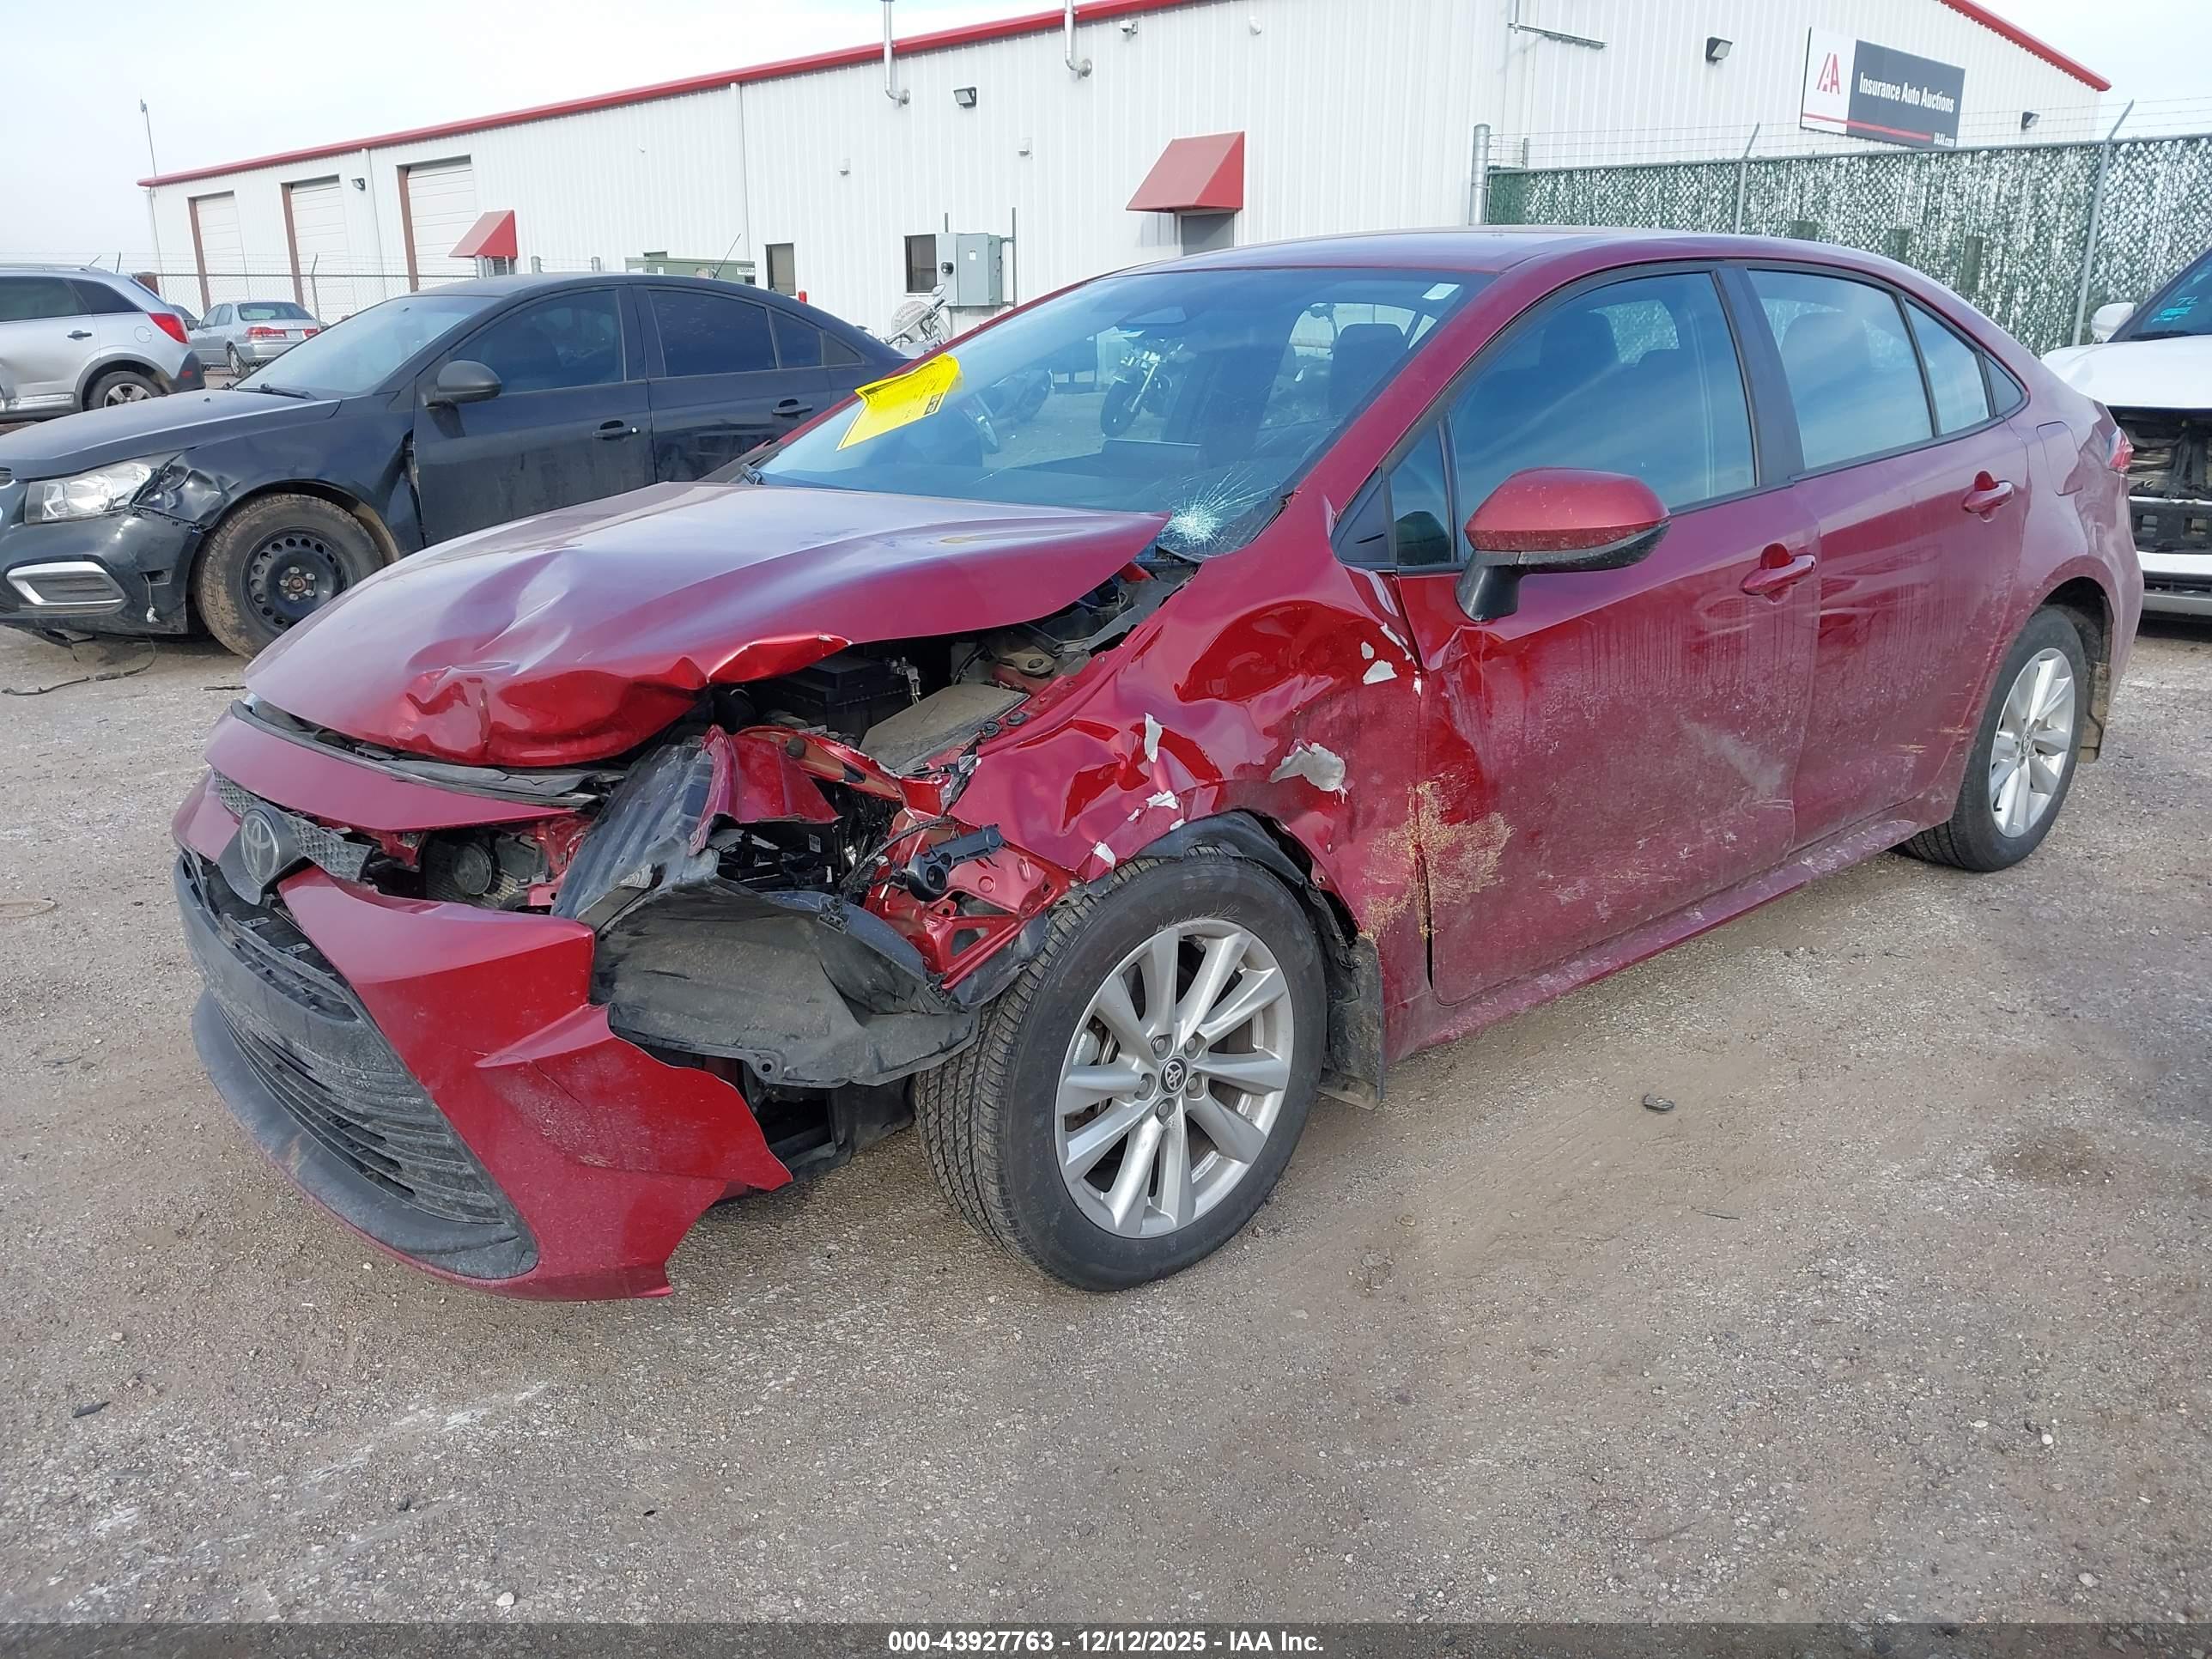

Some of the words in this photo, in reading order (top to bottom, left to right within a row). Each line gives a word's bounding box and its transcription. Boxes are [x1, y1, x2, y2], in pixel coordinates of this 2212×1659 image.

[1859, 71, 1901, 101] Insurance
[1901, 82, 1920, 106] Auto
[1920, 86, 1954, 113] Auctions
